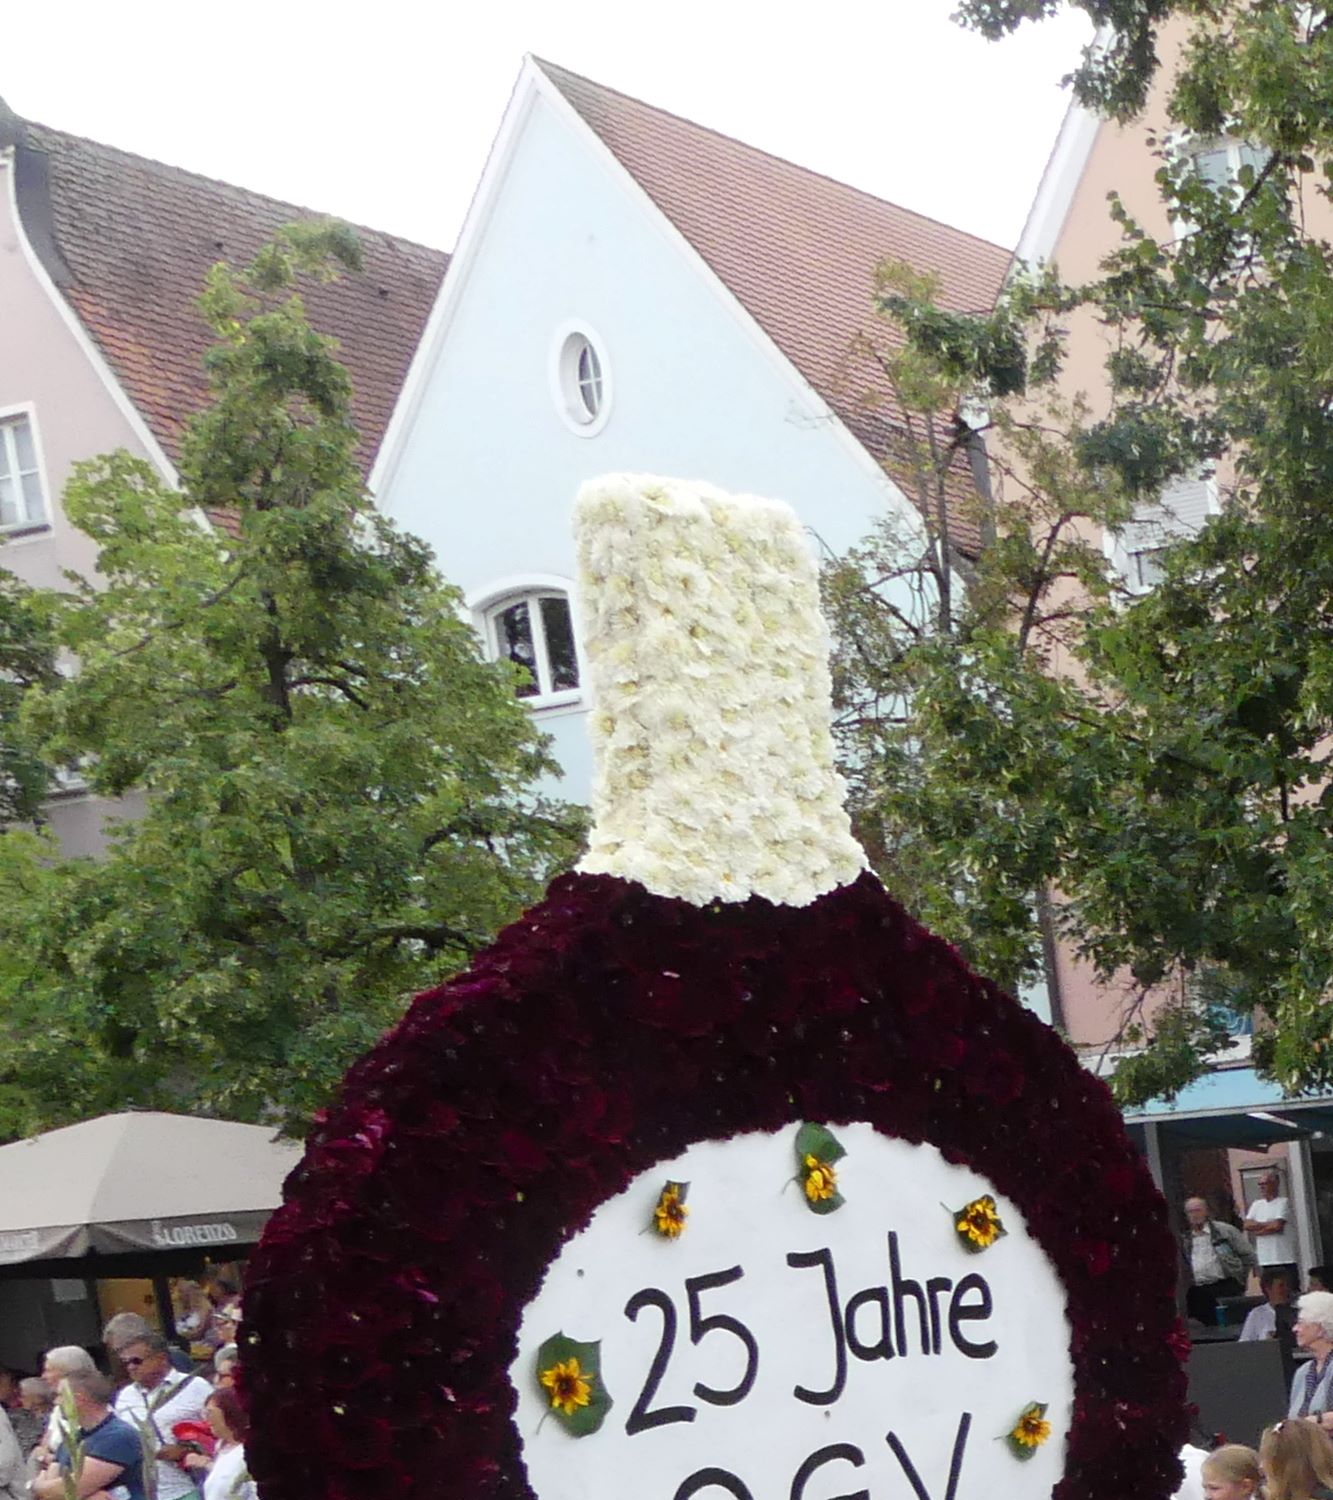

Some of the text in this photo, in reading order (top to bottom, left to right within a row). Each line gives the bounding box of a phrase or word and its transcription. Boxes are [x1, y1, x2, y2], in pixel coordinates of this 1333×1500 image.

[163, 1222, 238, 1246] LORENZO
[623, 1230, 999, 1436] 25 Jahre
